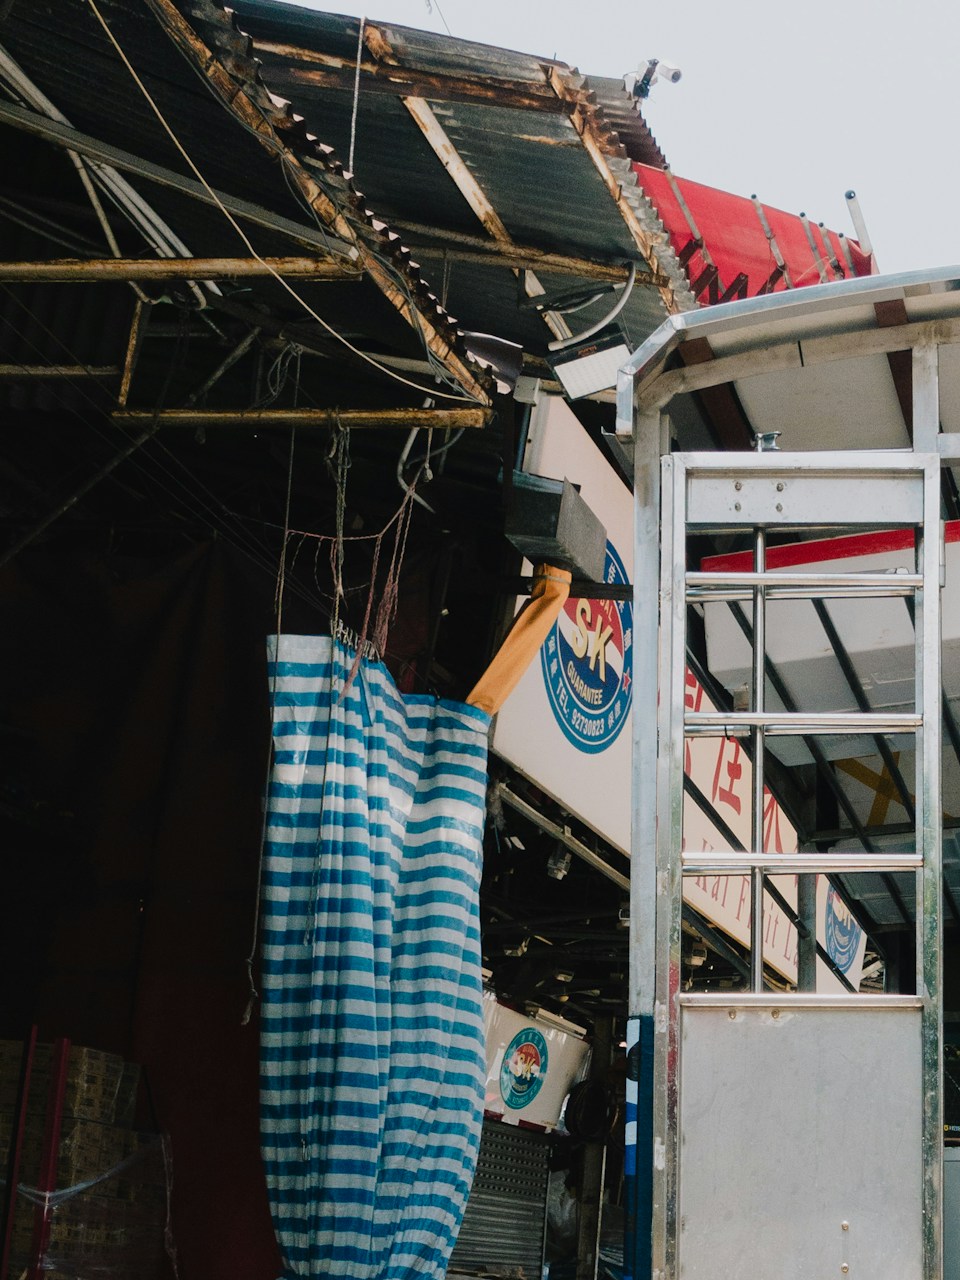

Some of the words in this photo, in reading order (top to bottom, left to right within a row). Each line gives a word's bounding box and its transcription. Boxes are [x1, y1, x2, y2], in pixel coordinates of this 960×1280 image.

[572, 598, 613, 682] SK
[567, 660, 603, 705] GUARANTEE
[571, 709, 604, 735] 92730823
